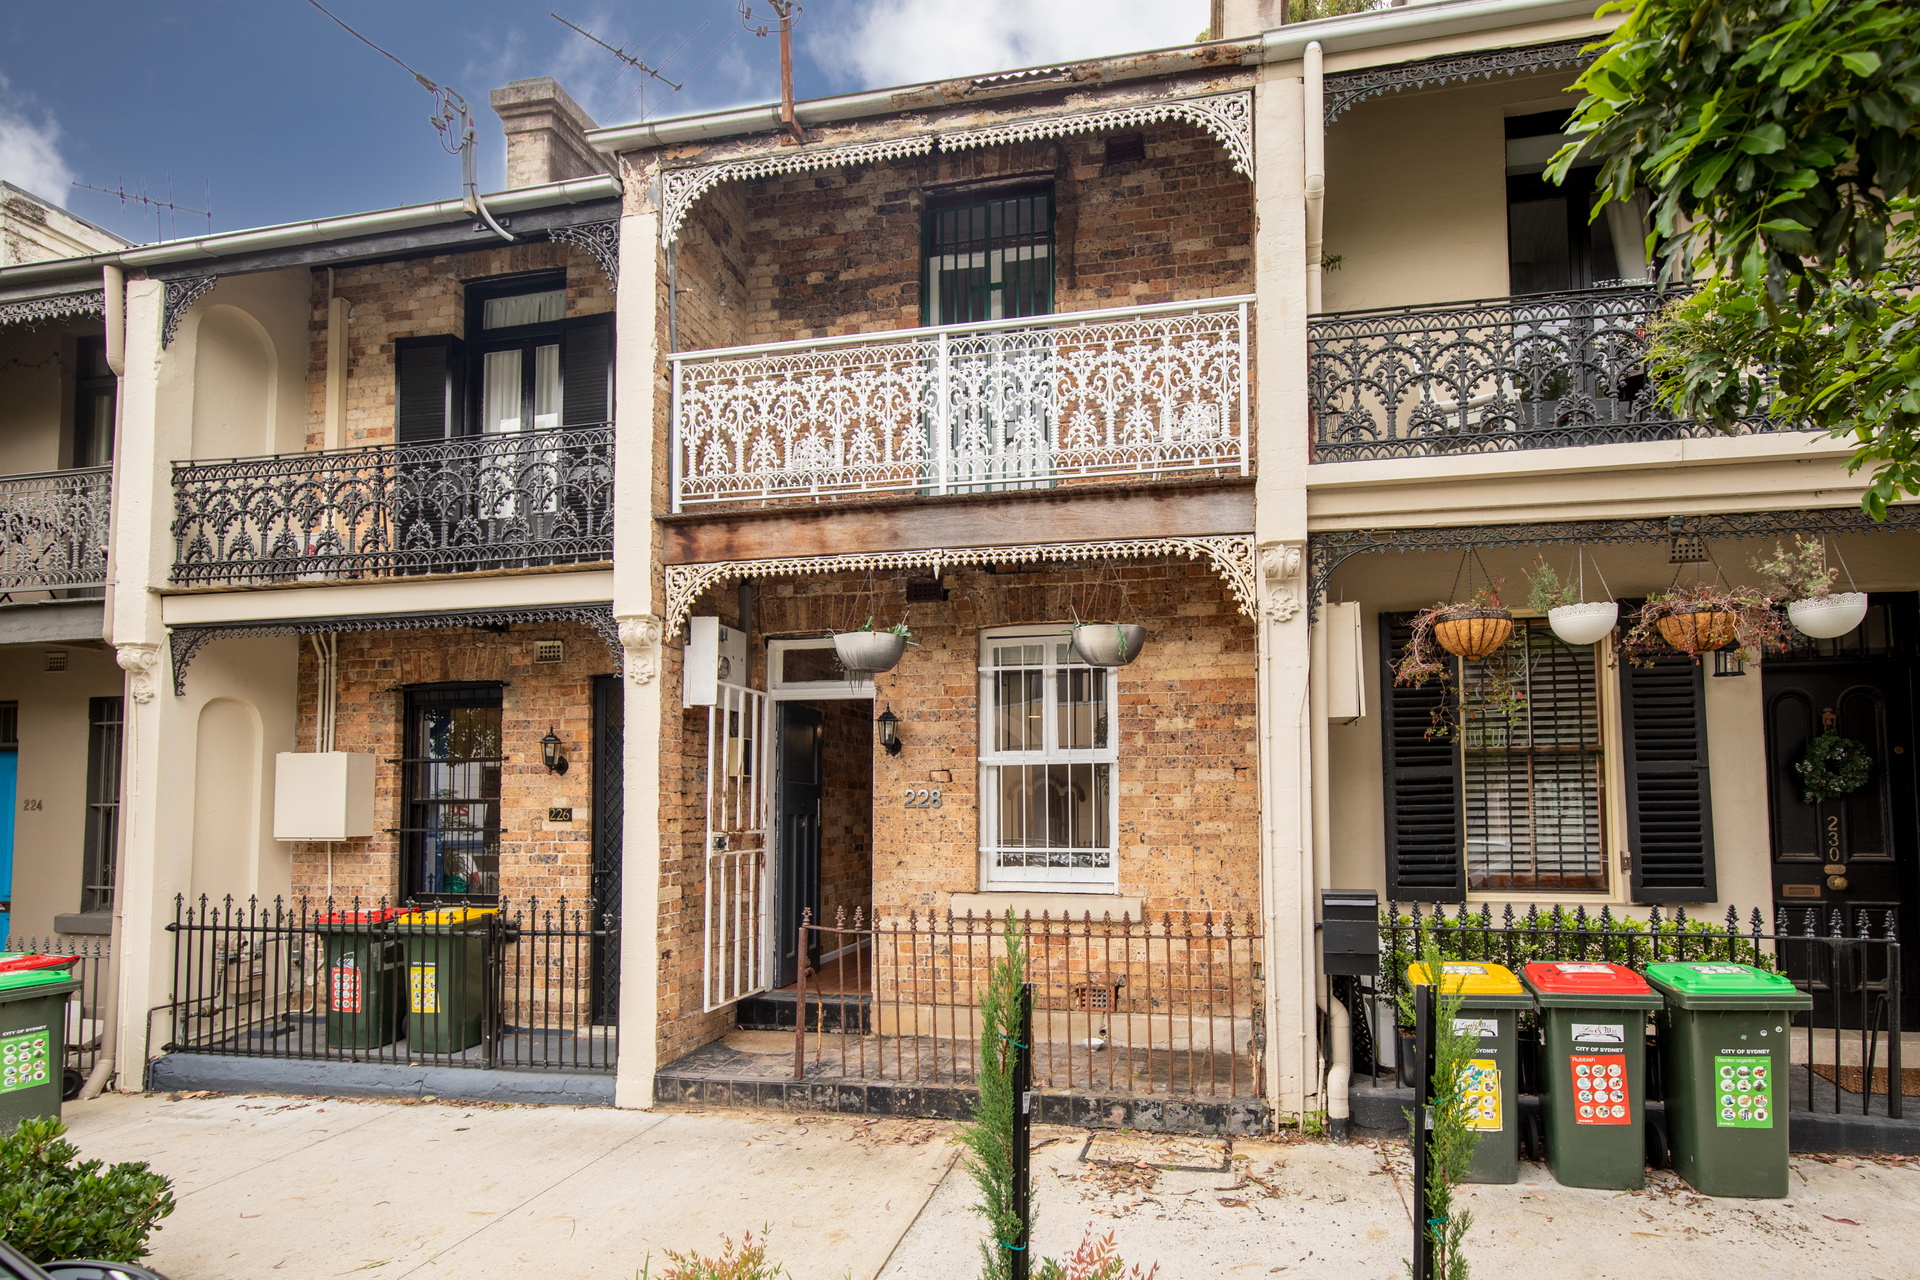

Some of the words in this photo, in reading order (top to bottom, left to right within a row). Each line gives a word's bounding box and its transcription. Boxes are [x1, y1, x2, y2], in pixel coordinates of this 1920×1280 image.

[23, 799, 43, 811] 224
[903, 789, 942, 809] 228
[549, 808, 570, 820] 226
[1827, 815, 1840, 862] 230
[25, 1024, 47, 1032] SYDNEY
